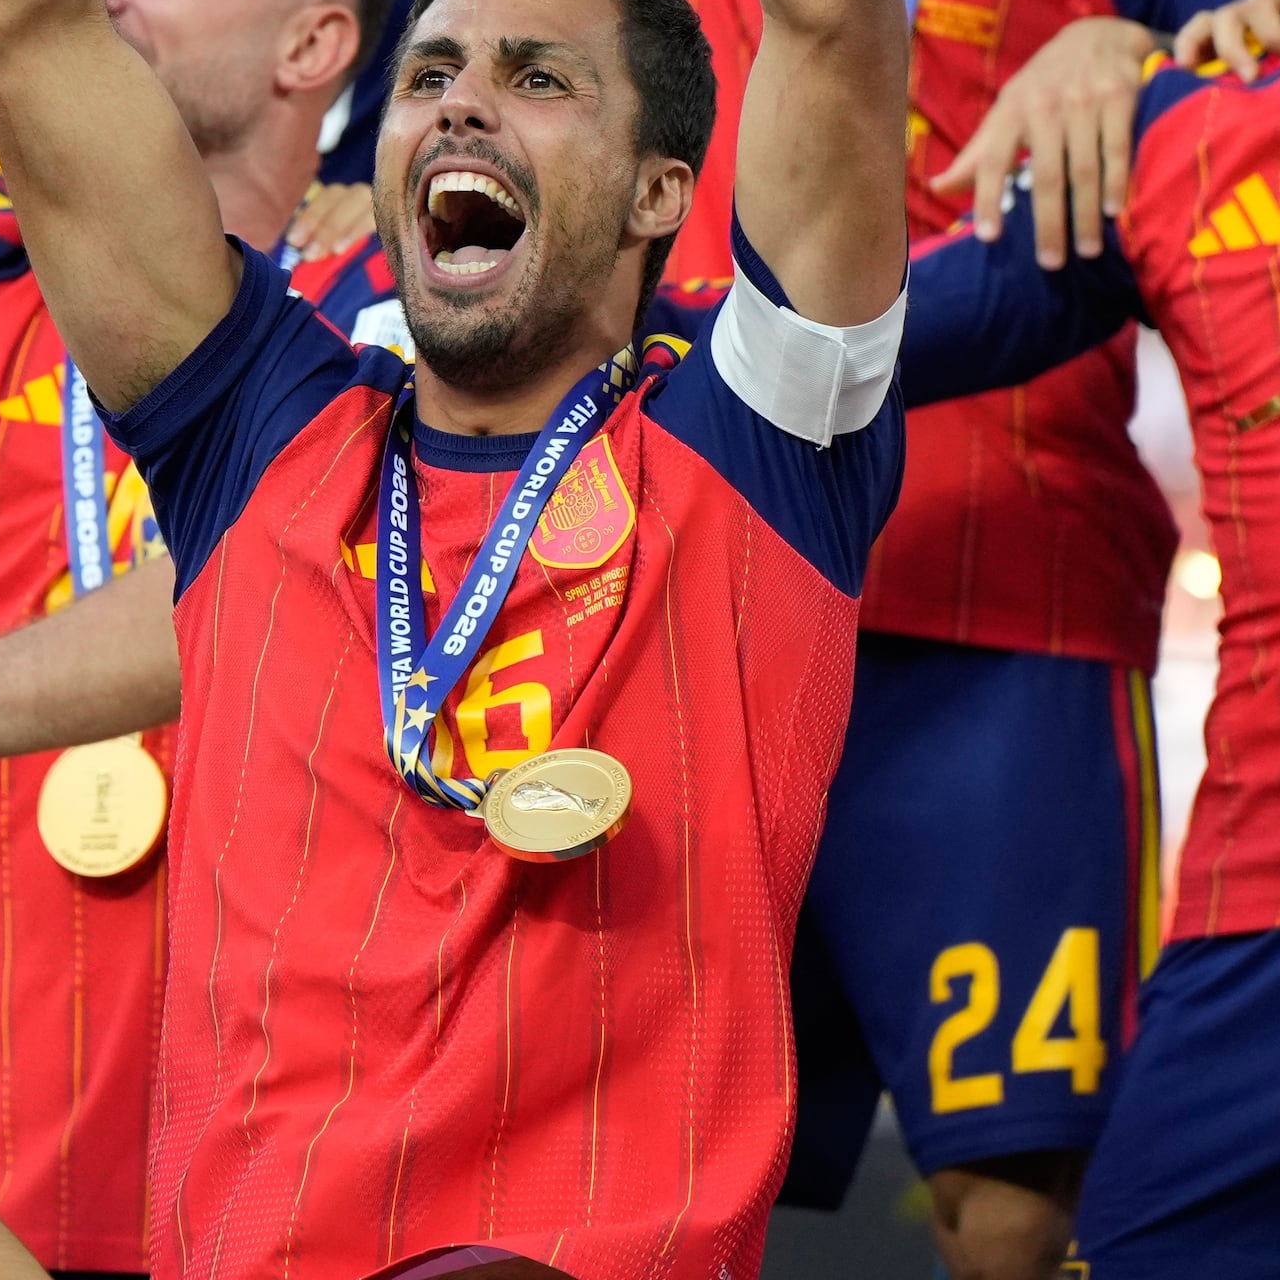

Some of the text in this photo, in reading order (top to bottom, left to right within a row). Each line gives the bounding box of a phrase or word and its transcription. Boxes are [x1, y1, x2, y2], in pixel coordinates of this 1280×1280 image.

[72, 447, 96, 498] CUP
[390, 454, 408, 531] 2026
[75, 498, 104, 590] 2026
[389, 534, 408, 577] CUP
[444, 394, 598, 657] FIFA WORLD CUP 2026
[389, 577, 412, 658] WORLD
[565, 583, 589, 601] SPAIN
[566, 611, 584, 627] NEW
[585, 602, 603, 617] YORK
[593, 587, 608, 601] JULY
[927, 927, 1107, 1114] 24
